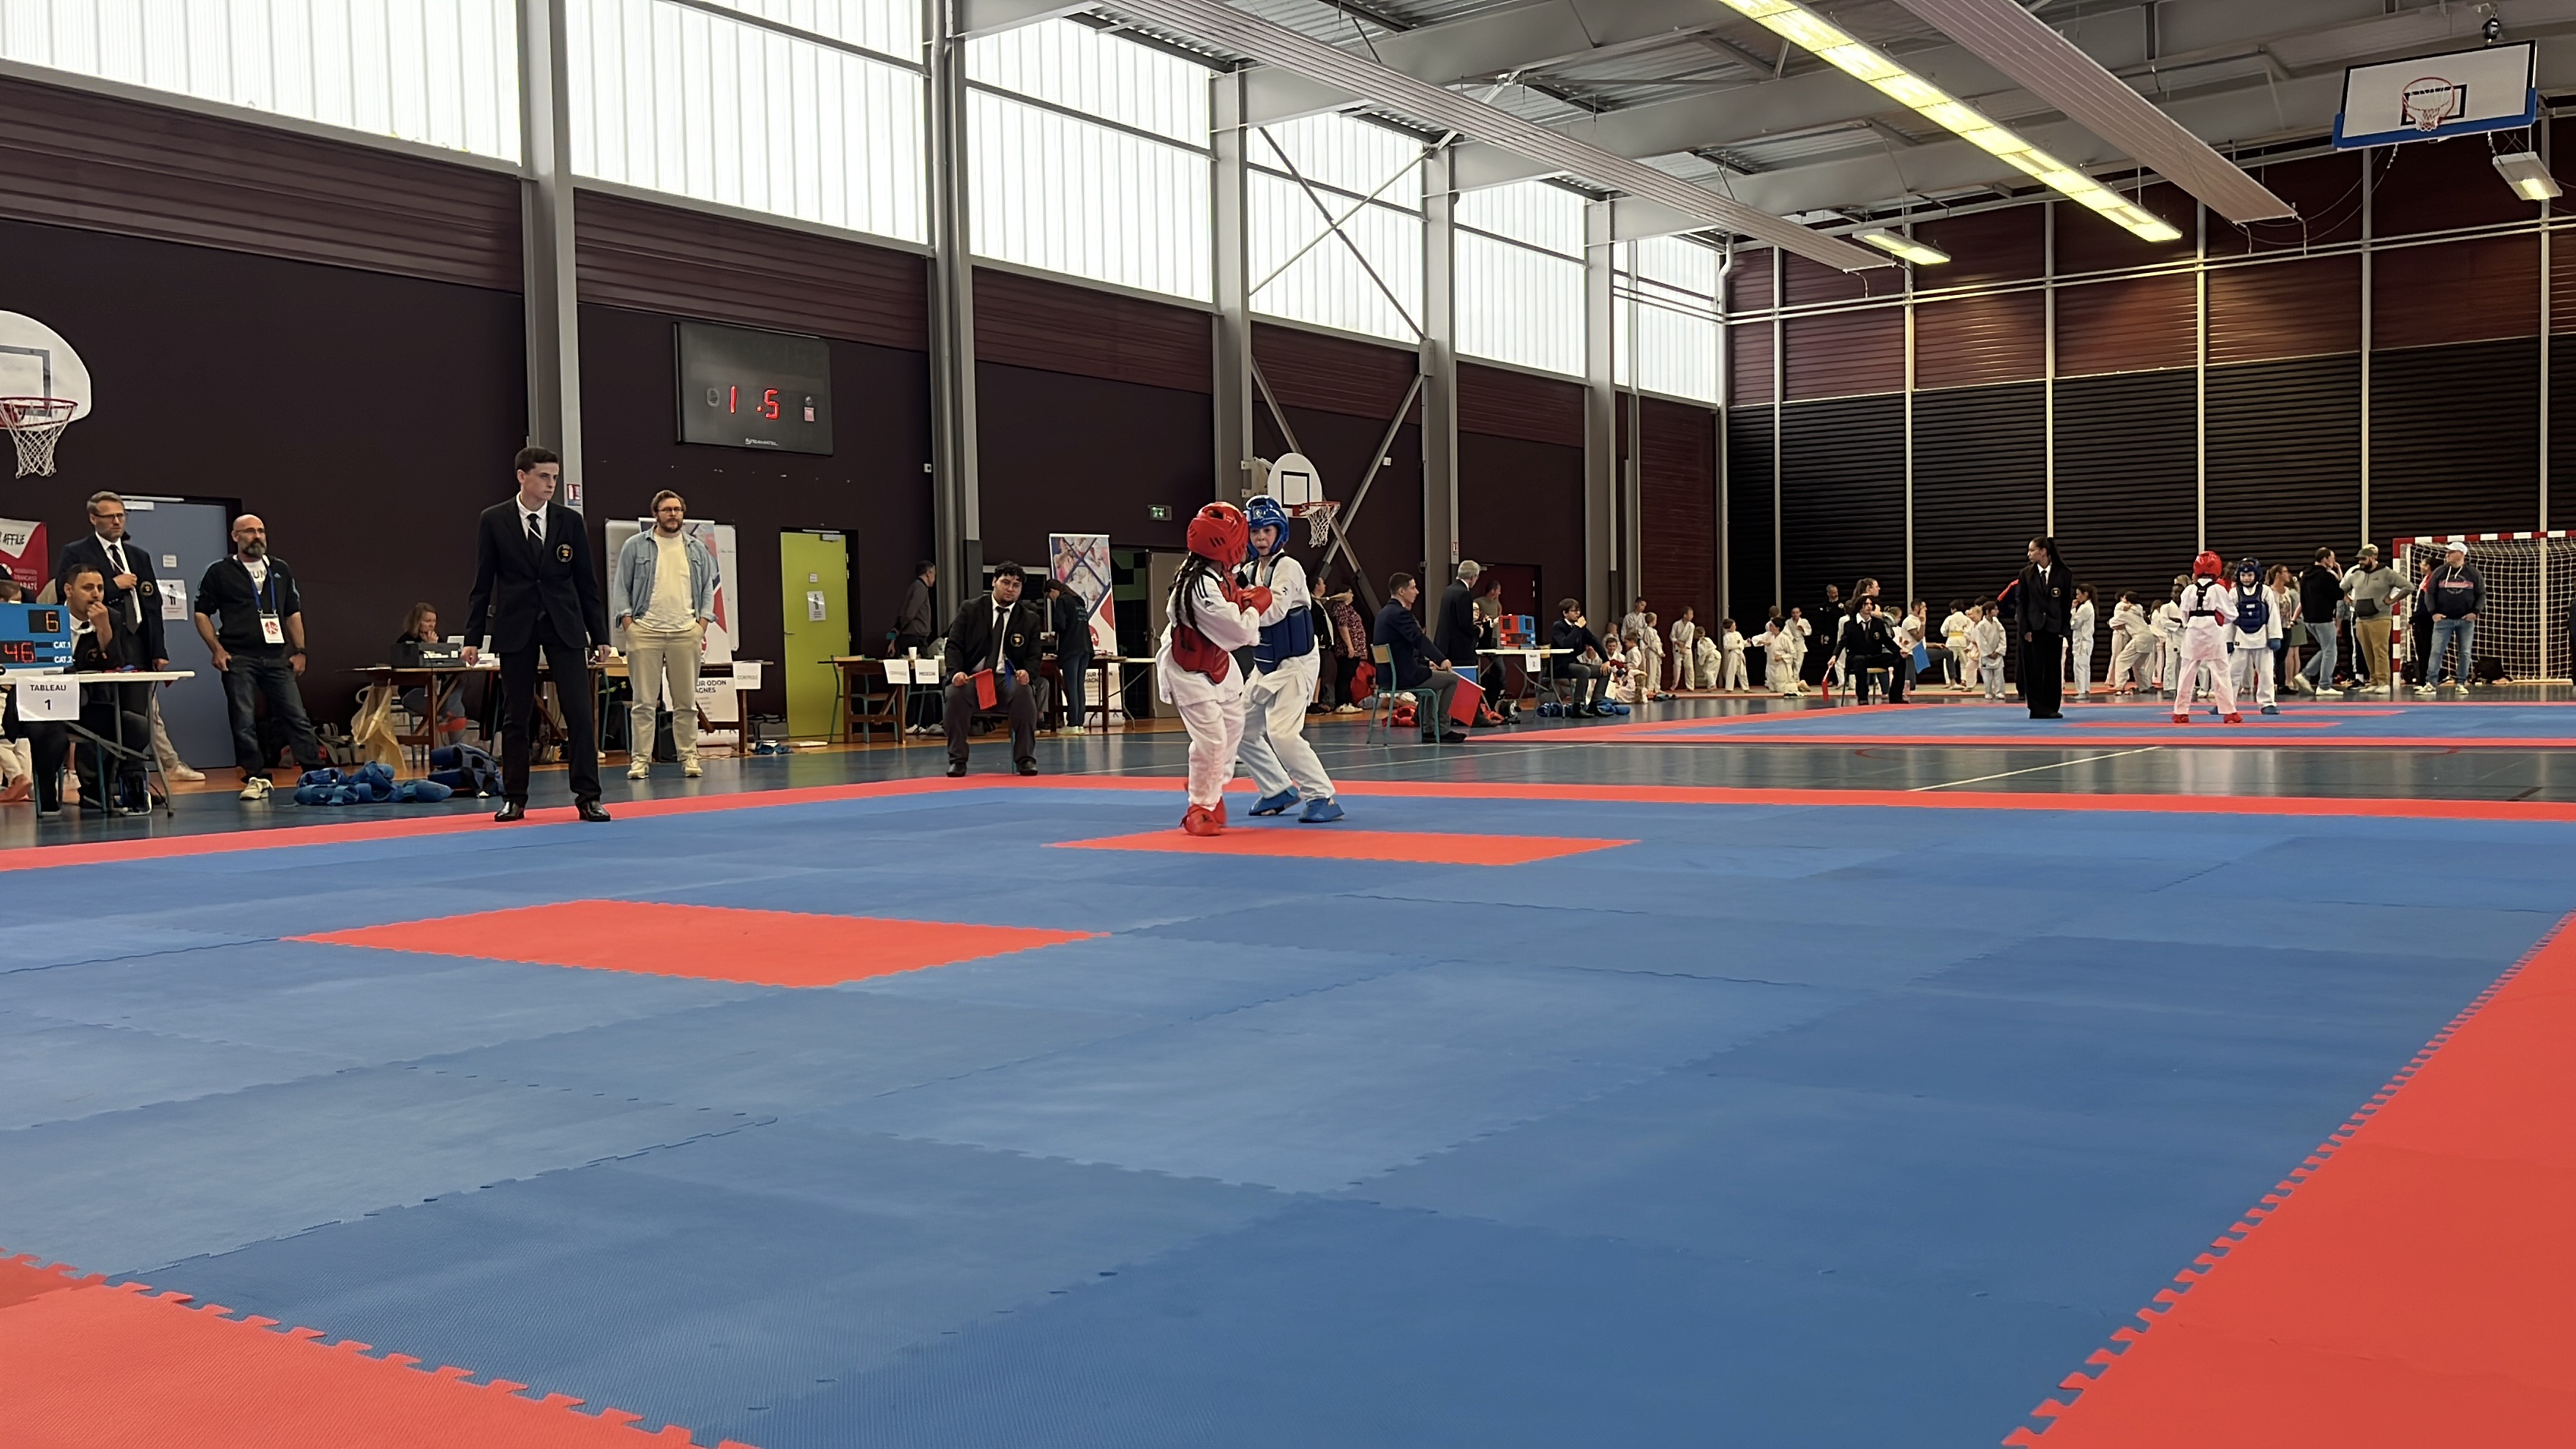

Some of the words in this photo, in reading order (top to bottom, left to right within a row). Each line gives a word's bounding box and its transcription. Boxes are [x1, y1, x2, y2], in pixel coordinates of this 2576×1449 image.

[45, 611, 59, 632] 6
[53, 641, 71, 649] CAT.1
[4, 642, 35, 664] 46
[53, 656, 73, 664] CAT.2
[45, 699, 51, 711] 1
